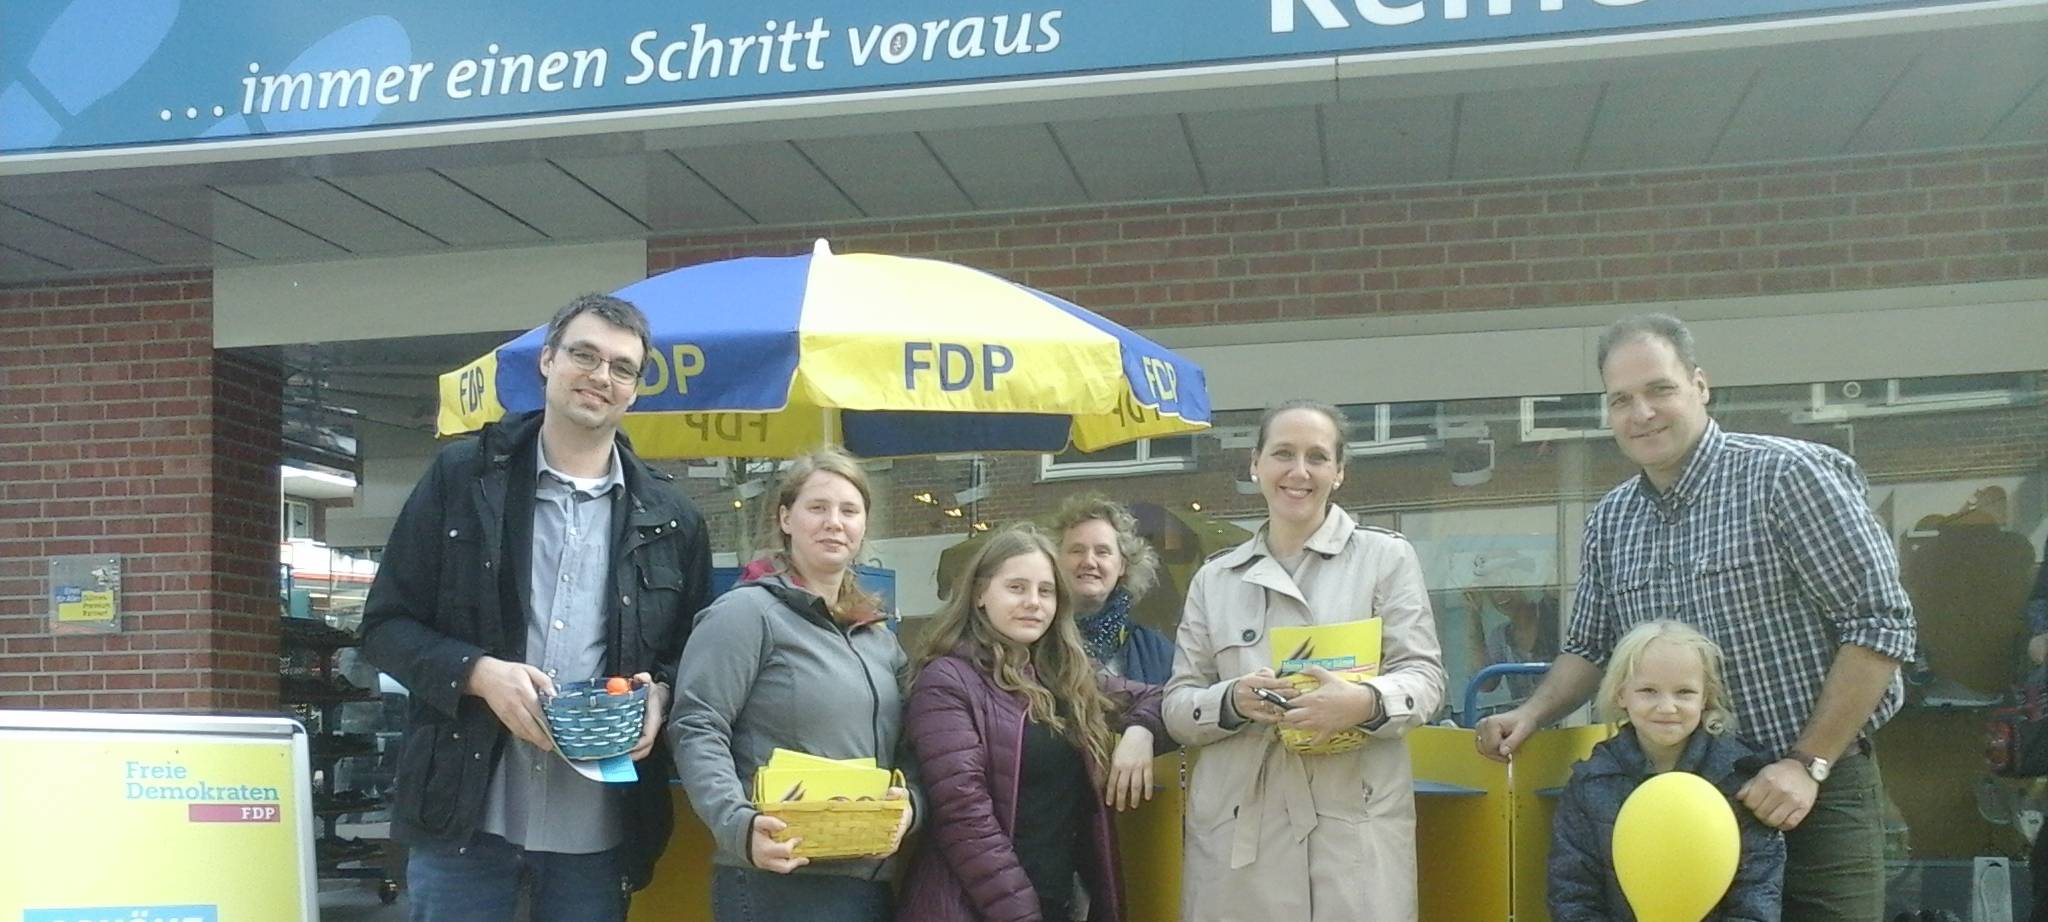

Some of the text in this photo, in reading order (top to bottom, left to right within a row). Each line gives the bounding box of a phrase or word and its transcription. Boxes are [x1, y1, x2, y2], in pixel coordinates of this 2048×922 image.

[241, 61, 435, 115] immer
[445, 43, 608, 100] einen
[623, 17, 831, 85] Schritt
[847, 9, 1063, 67] voraus
[460, 366, 485, 416] FDP
[904, 341, 1014, 392] FDP
[1142, 355, 1179, 404] FDP
[126, 761, 187, 779] Freie
[126, 781, 280, 801] Demokraten
[241, 807, 275, 820] FDP
